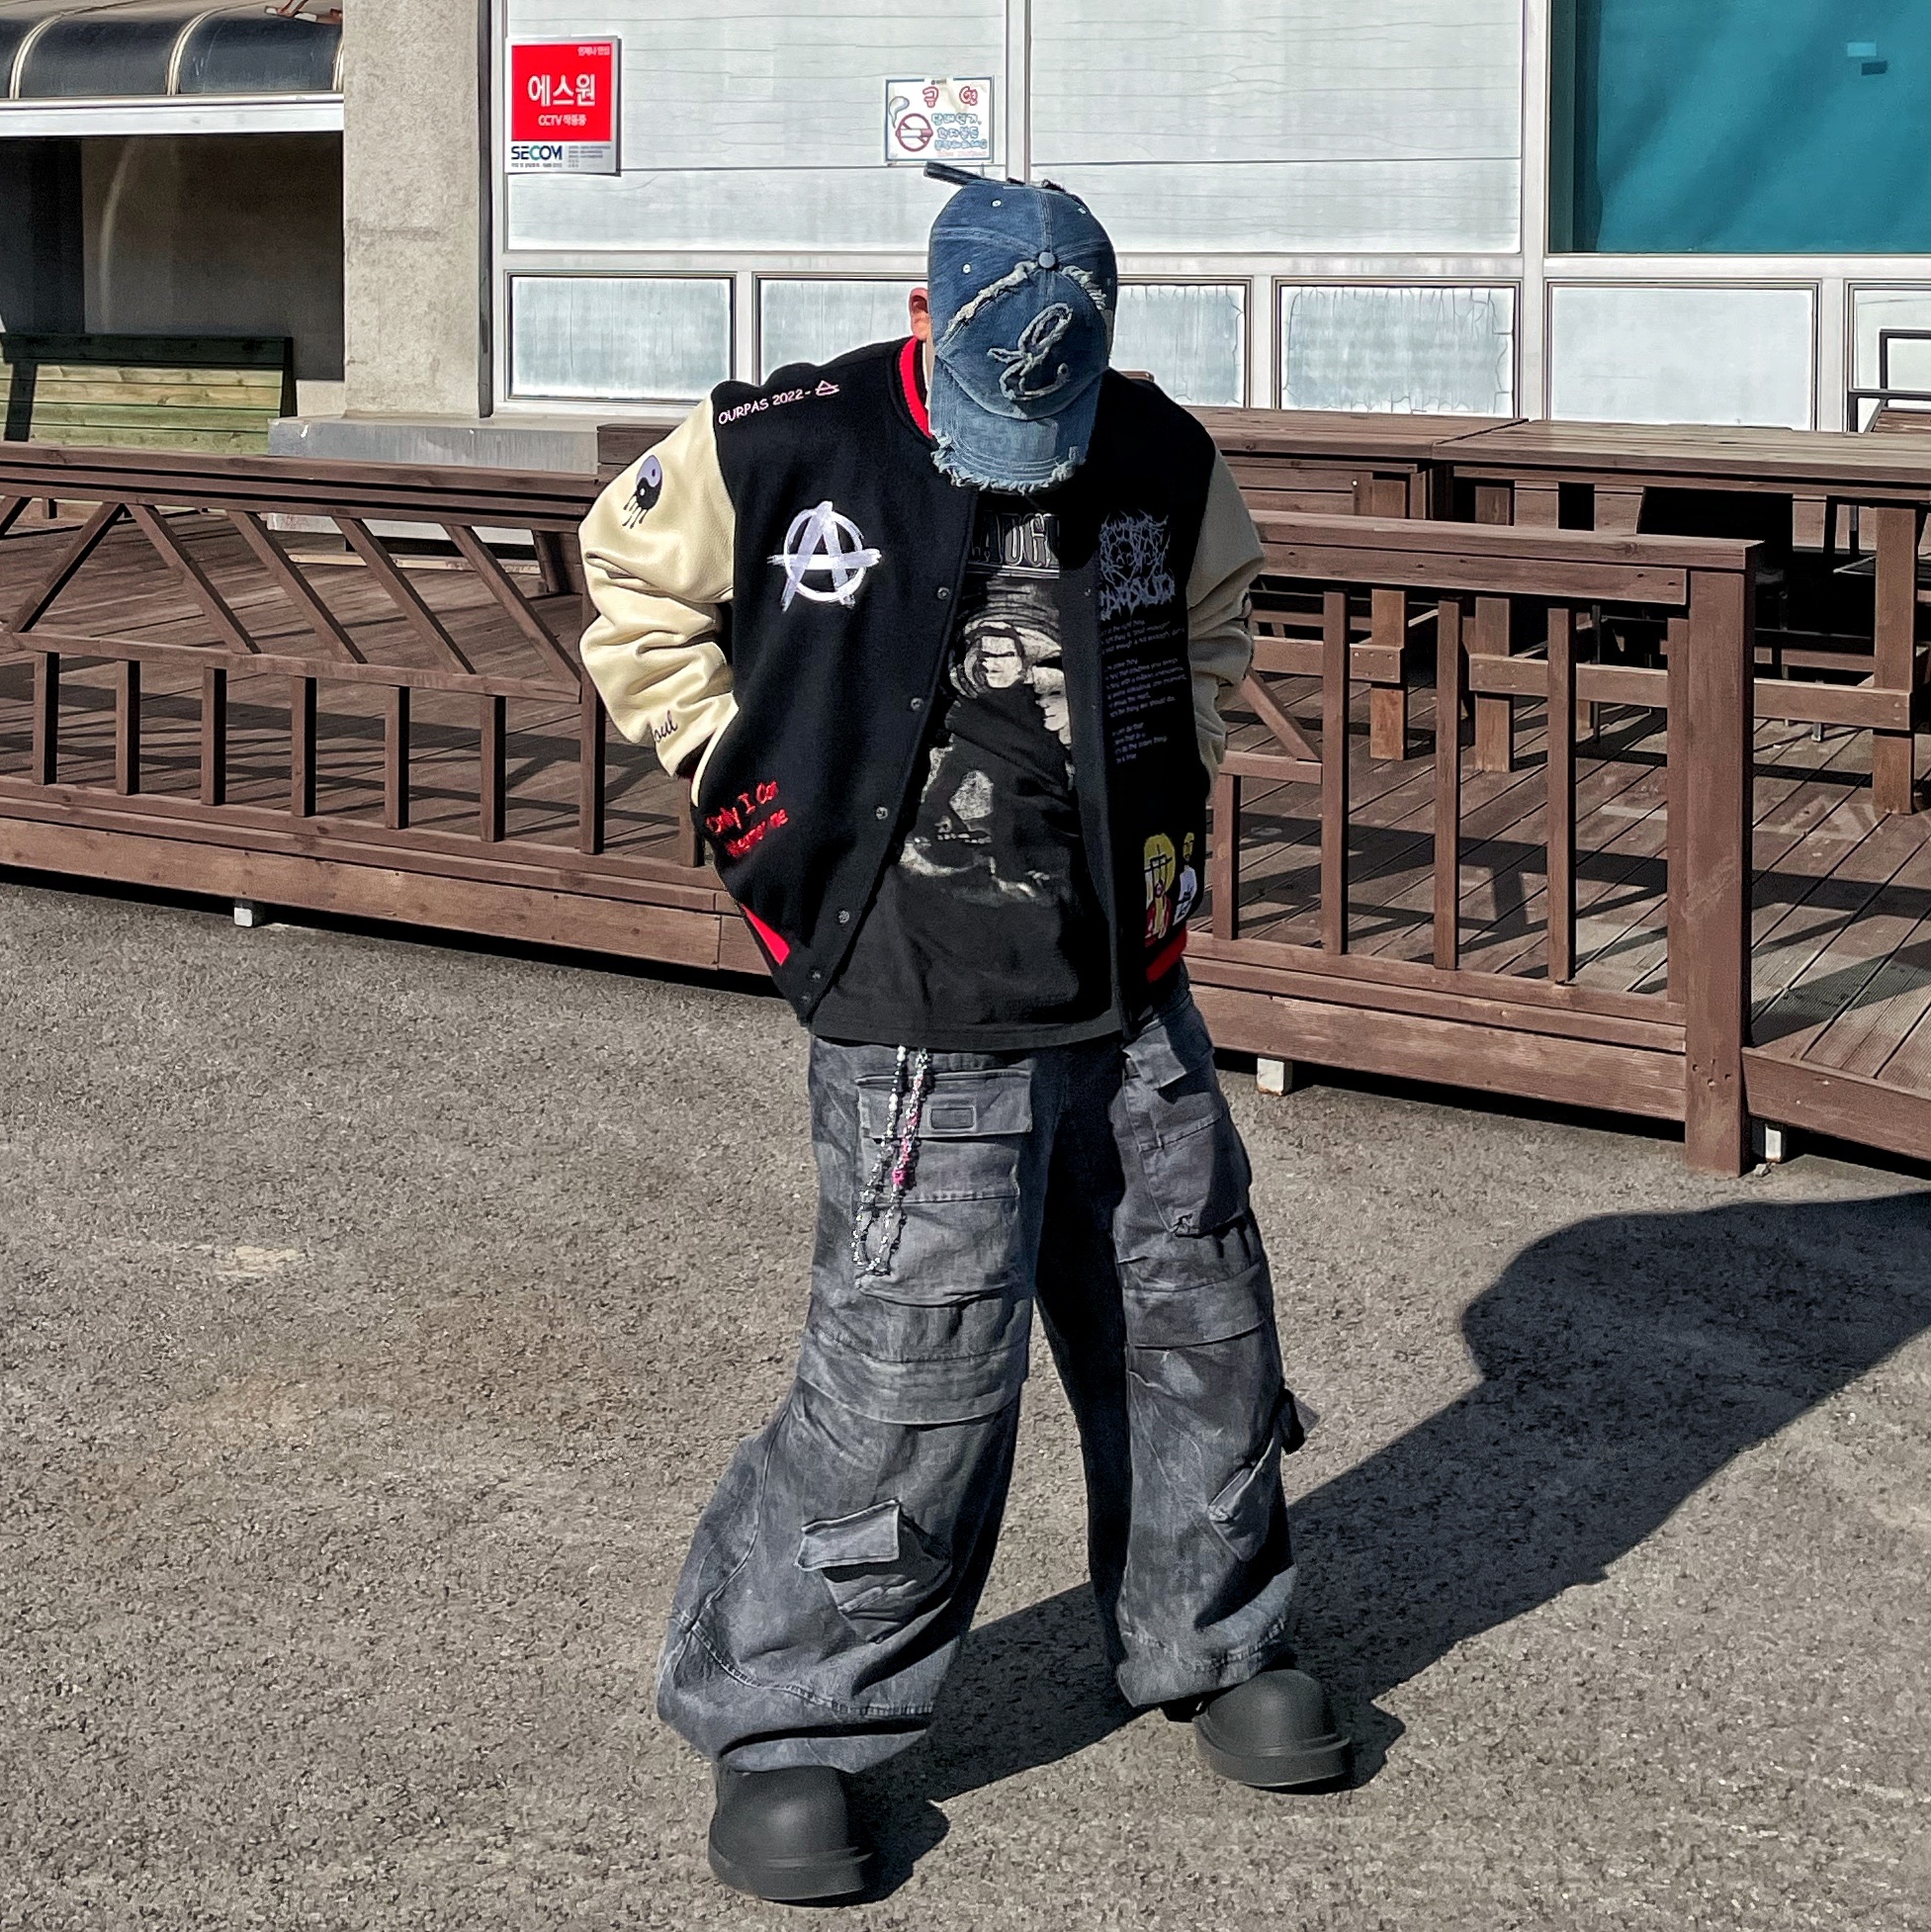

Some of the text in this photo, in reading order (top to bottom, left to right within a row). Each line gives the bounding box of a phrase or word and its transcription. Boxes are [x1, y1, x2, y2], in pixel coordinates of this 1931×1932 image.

[527, 73, 596, 107] 에스원
[538, 115, 563, 126] CCTV
[511, 145, 563, 160] SECOM
[718, 397, 769, 425] OURPAS
